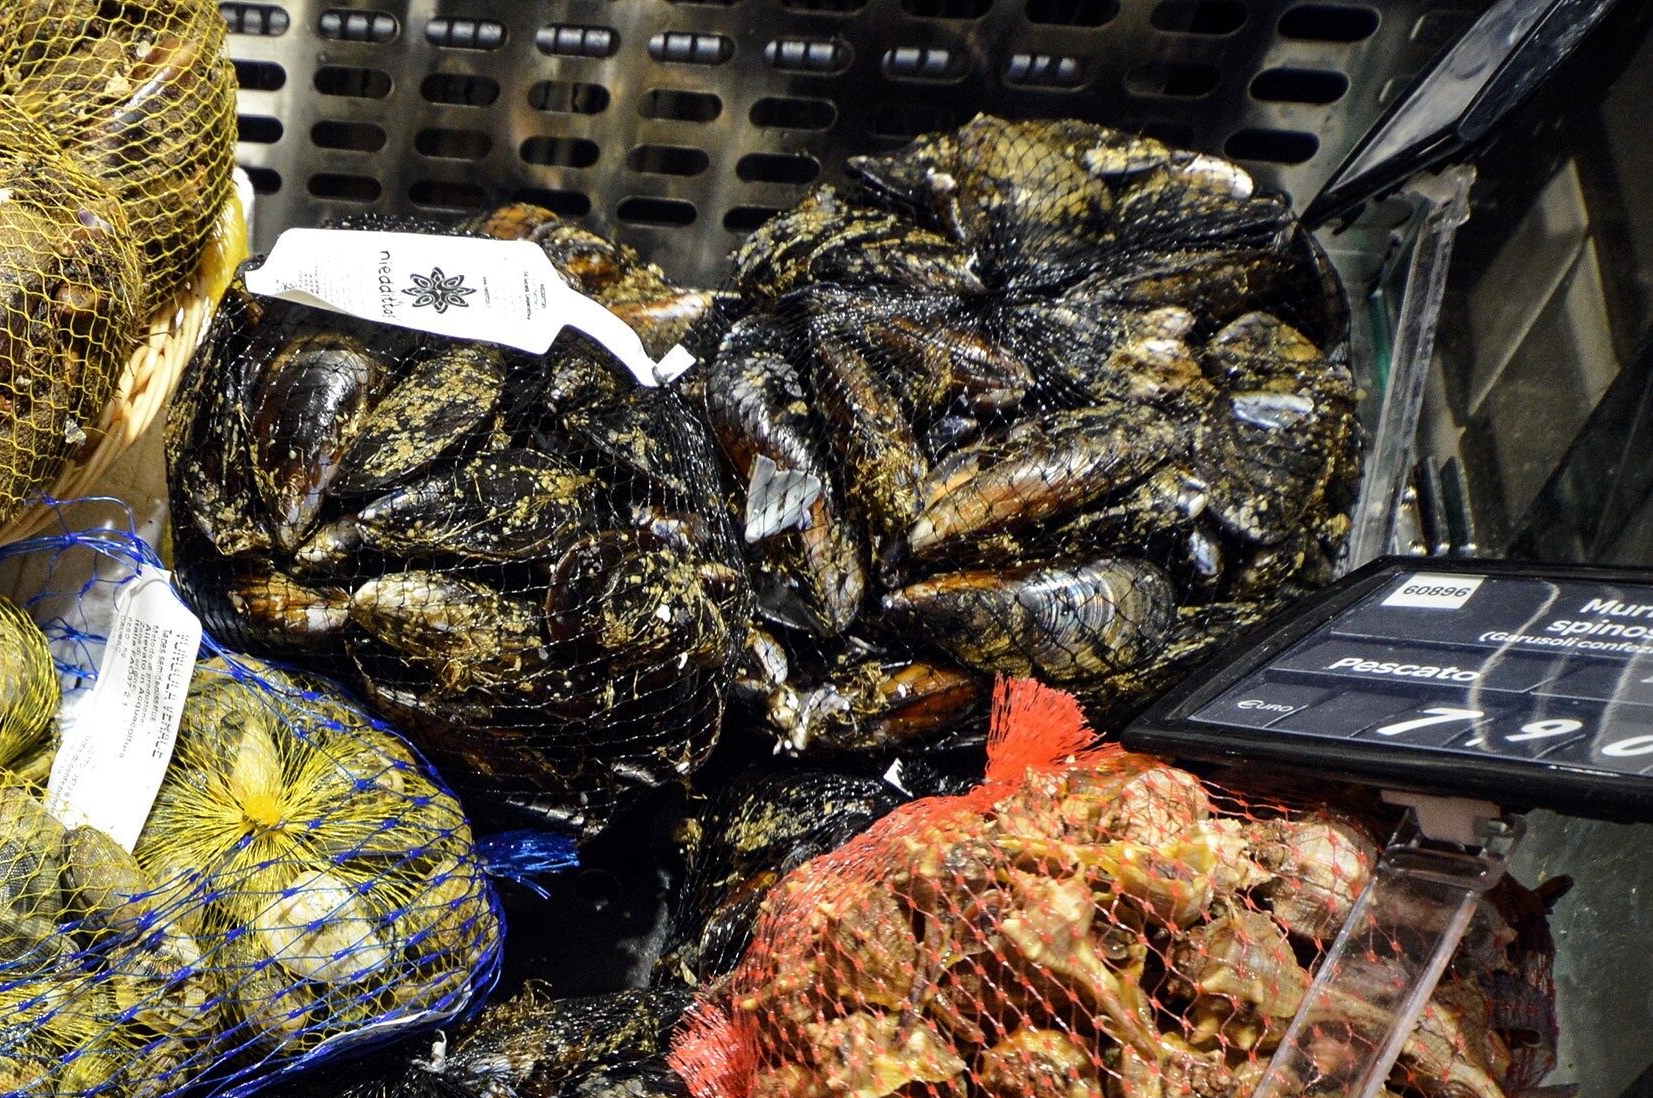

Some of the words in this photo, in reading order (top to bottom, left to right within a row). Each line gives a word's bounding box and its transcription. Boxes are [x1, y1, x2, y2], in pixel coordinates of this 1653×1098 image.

[1402, 585, 1471, 599] 60896
[129, 618, 141, 647] Italia
[138, 624, 153, 670] Allevato
[124, 649, 136, 688] FAO37
[138, 672, 146, 683] in
[1328, 657, 1481, 683] Pescato
[118, 687, 145, 758] Acquacoltura
